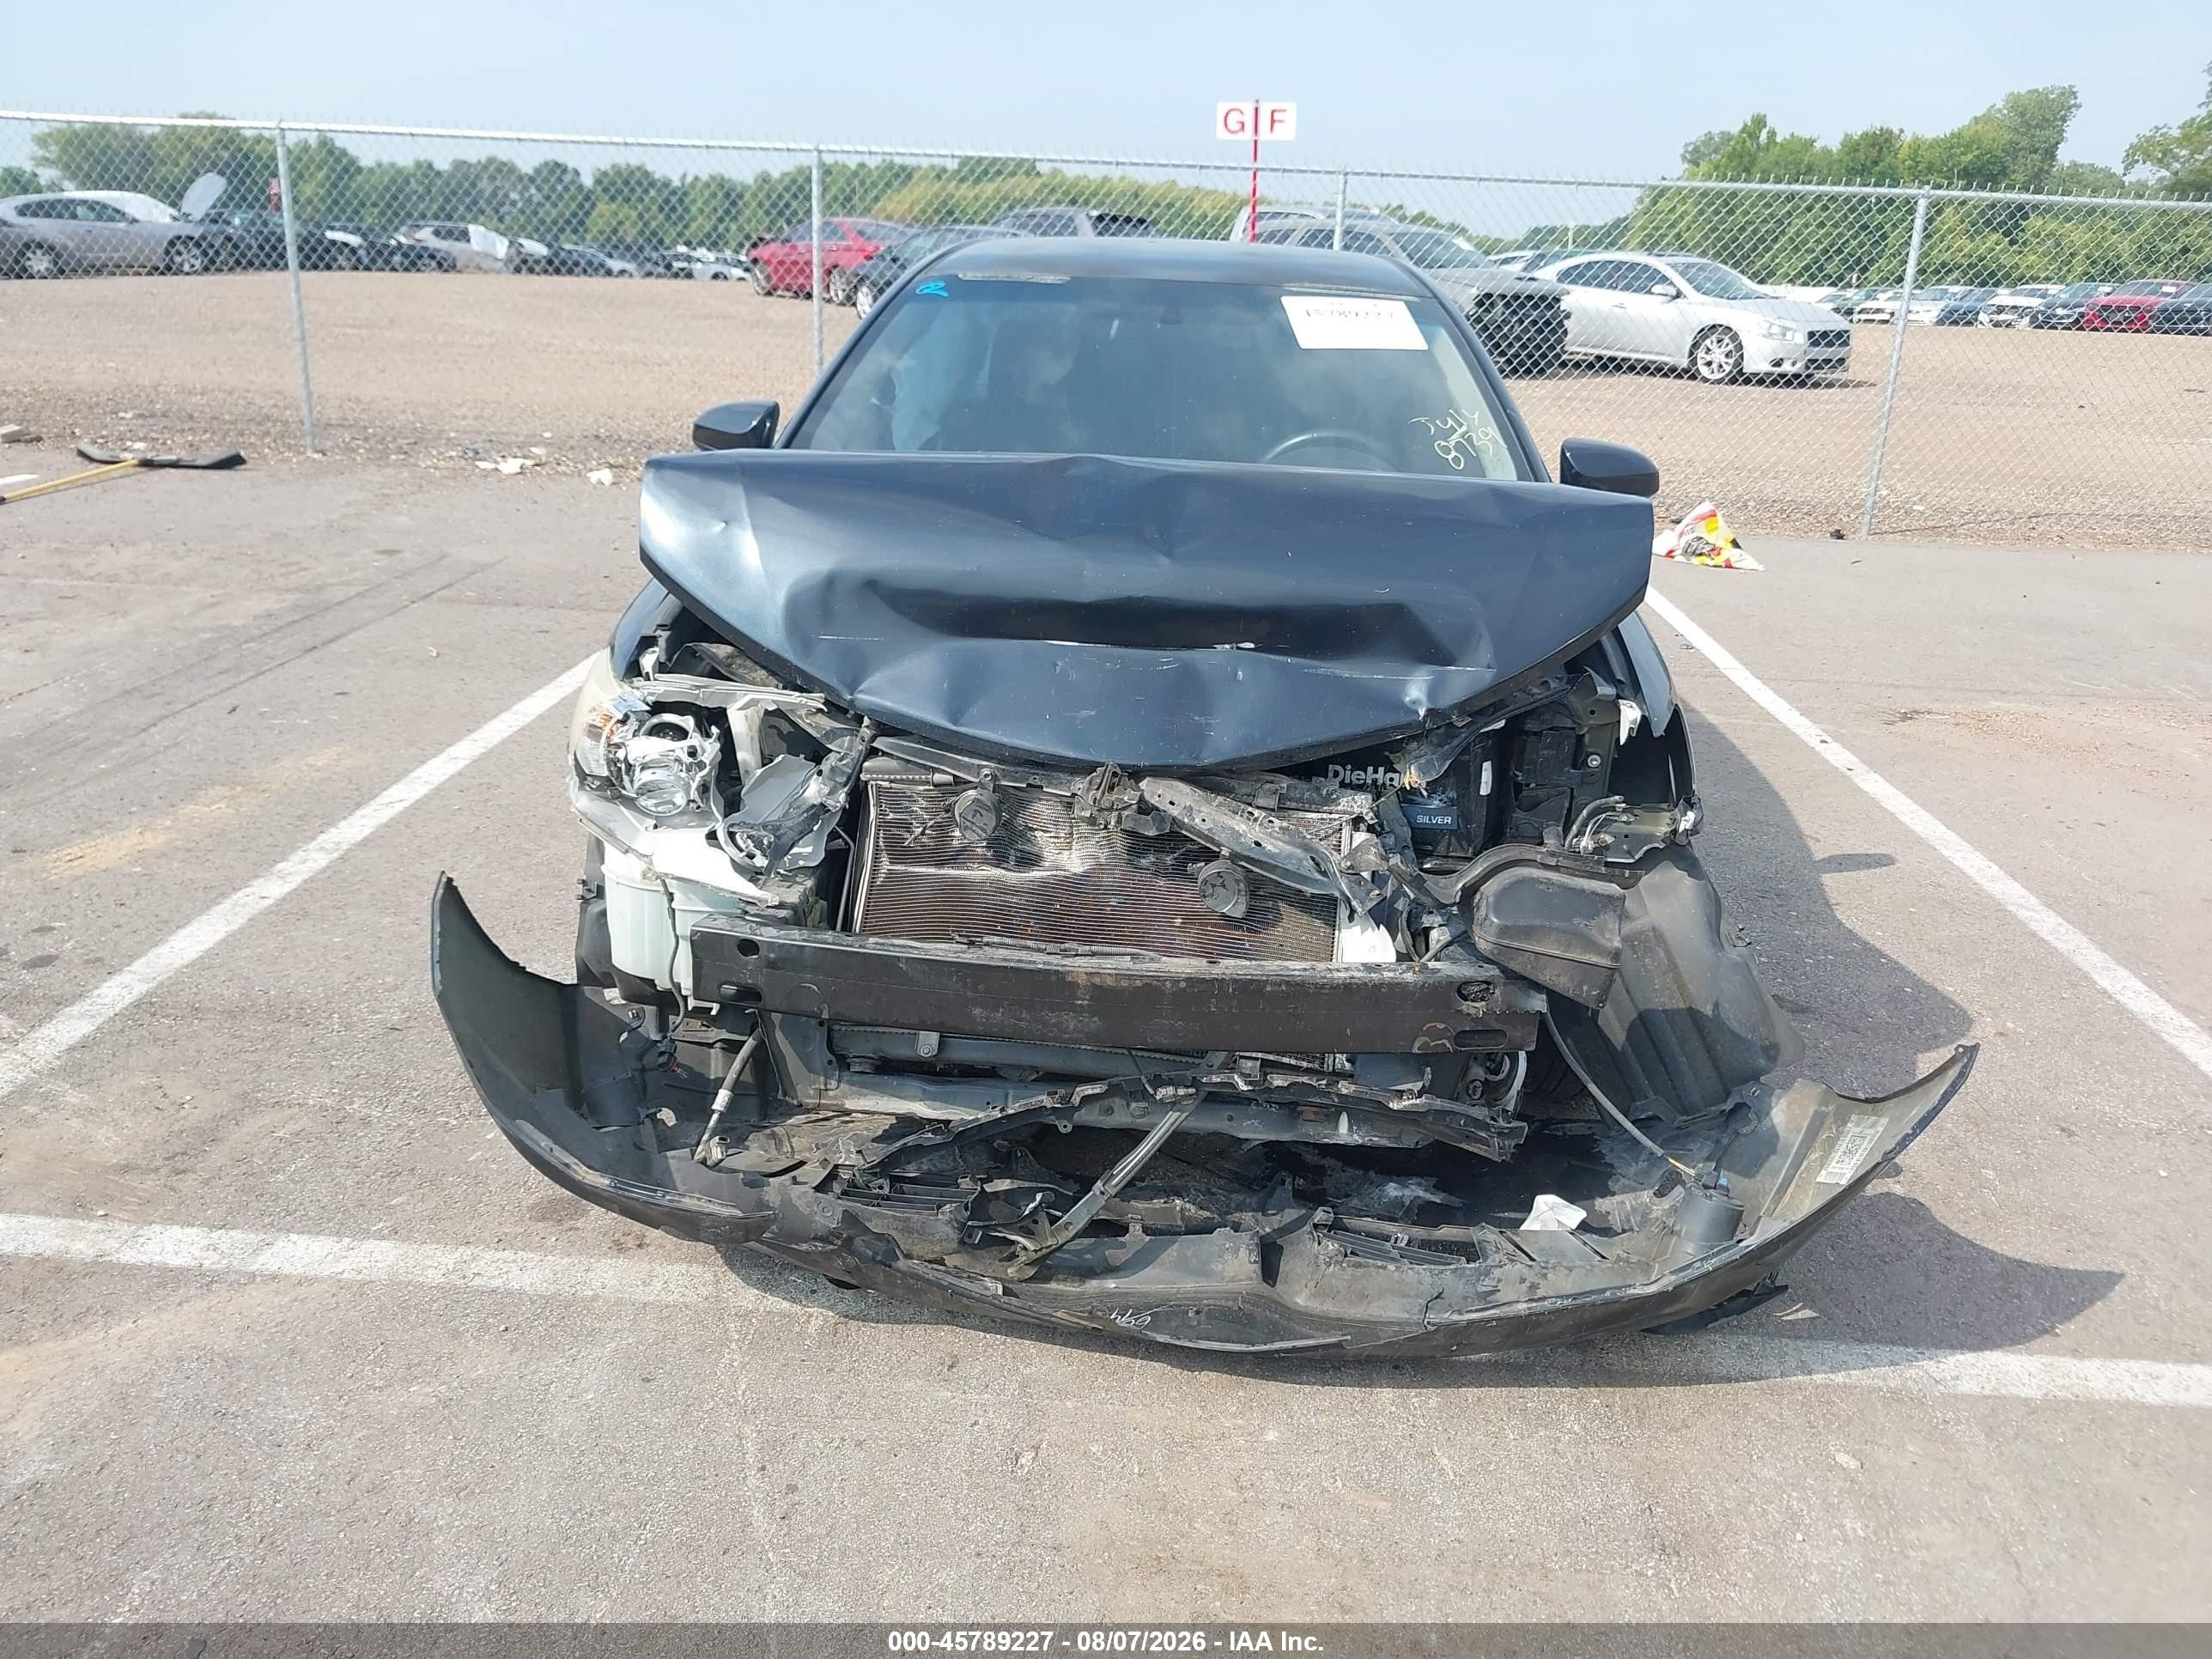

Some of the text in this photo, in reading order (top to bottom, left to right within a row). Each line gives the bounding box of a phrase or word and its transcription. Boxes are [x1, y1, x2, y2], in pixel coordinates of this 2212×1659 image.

[1224, 107, 1245, 135] G
[1270, 108, 1287, 134] F
[1416, 814, 1452, 825] SILVER
